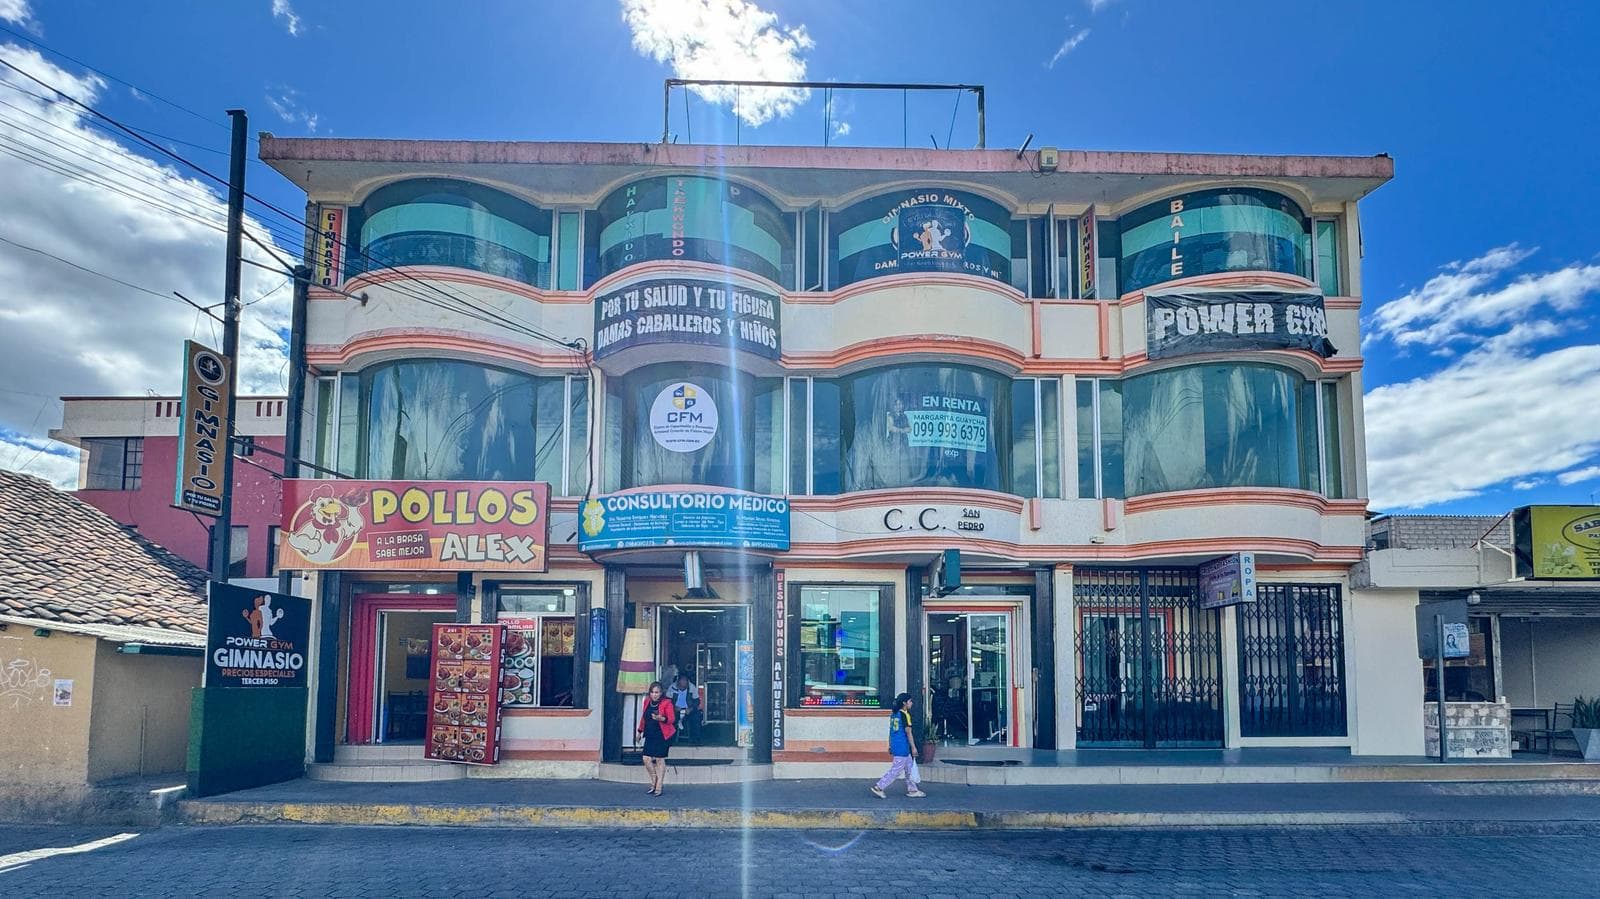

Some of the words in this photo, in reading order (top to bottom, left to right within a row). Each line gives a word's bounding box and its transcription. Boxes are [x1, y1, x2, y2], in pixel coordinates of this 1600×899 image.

[1170, 199, 1184, 276] BAILE
[323, 212, 337, 286] GIMNASIO
[900, 250, 939, 260] POWER
[940, 250, 963, 260] GYM
[1082, 215, 1091, 290] GIMNASIO
[601, 297, 621, 320] POR
[624, 289, 639, 313] TU
[643, 284, 687, 309] SALUD
[693, 286, 703, 308] Y
[707, 288, 726, 310] TU
[731, 291, 775, 320] FIGURA
[597, 319, 633, 351] DAMAS
[636, 313, 722, 335] CABALLEROS
[727, 317, 735, 337] Y
[740, 319, 777, 350] NIÑOS
[1153, 303, 1275, 340] POWER
[922, 395, 940, 407] EN
[942, 396, 981, 412] RENTA
[667, 411, 703, 424] CFM
[191, 385, 220, 491] GIMNASIO
[913, 421, 934, 437] 099
[937, 421, 958, 439] 993
[960, 423, 986, 442] 6379
[370, 487, 539, 526] POLLOS
[607, 494, 725, 512] CONSULTORIO
[962, 507, 981, 518] SAN
[957, 520, 985, 531] PEDRO
[376, 537, 383, 546] A
[384, 536, 395, 546] LA
[396, 534, 424, 545] BRASA
[439, 532, 536, 564] ALEX
[375, 547, 397, 559] SABE
[398, 546, 425, 557] MEJOR
[1244, 556, 1252, 597] ROPA
[776, 572, 784, 657] DESAYUNOS
[226, 636, 268, 648] POWER
[270, 640, 294, 650] GYM
[213, 648, 303, 670] GIMNASIO
[222, 668, 254, 677] PRECIOS
[255, 669, 295, 678] ESPECIALES
[241, 677, 265, 685] TERCER
[773, 662, 782, 747] ALMUERZOS
